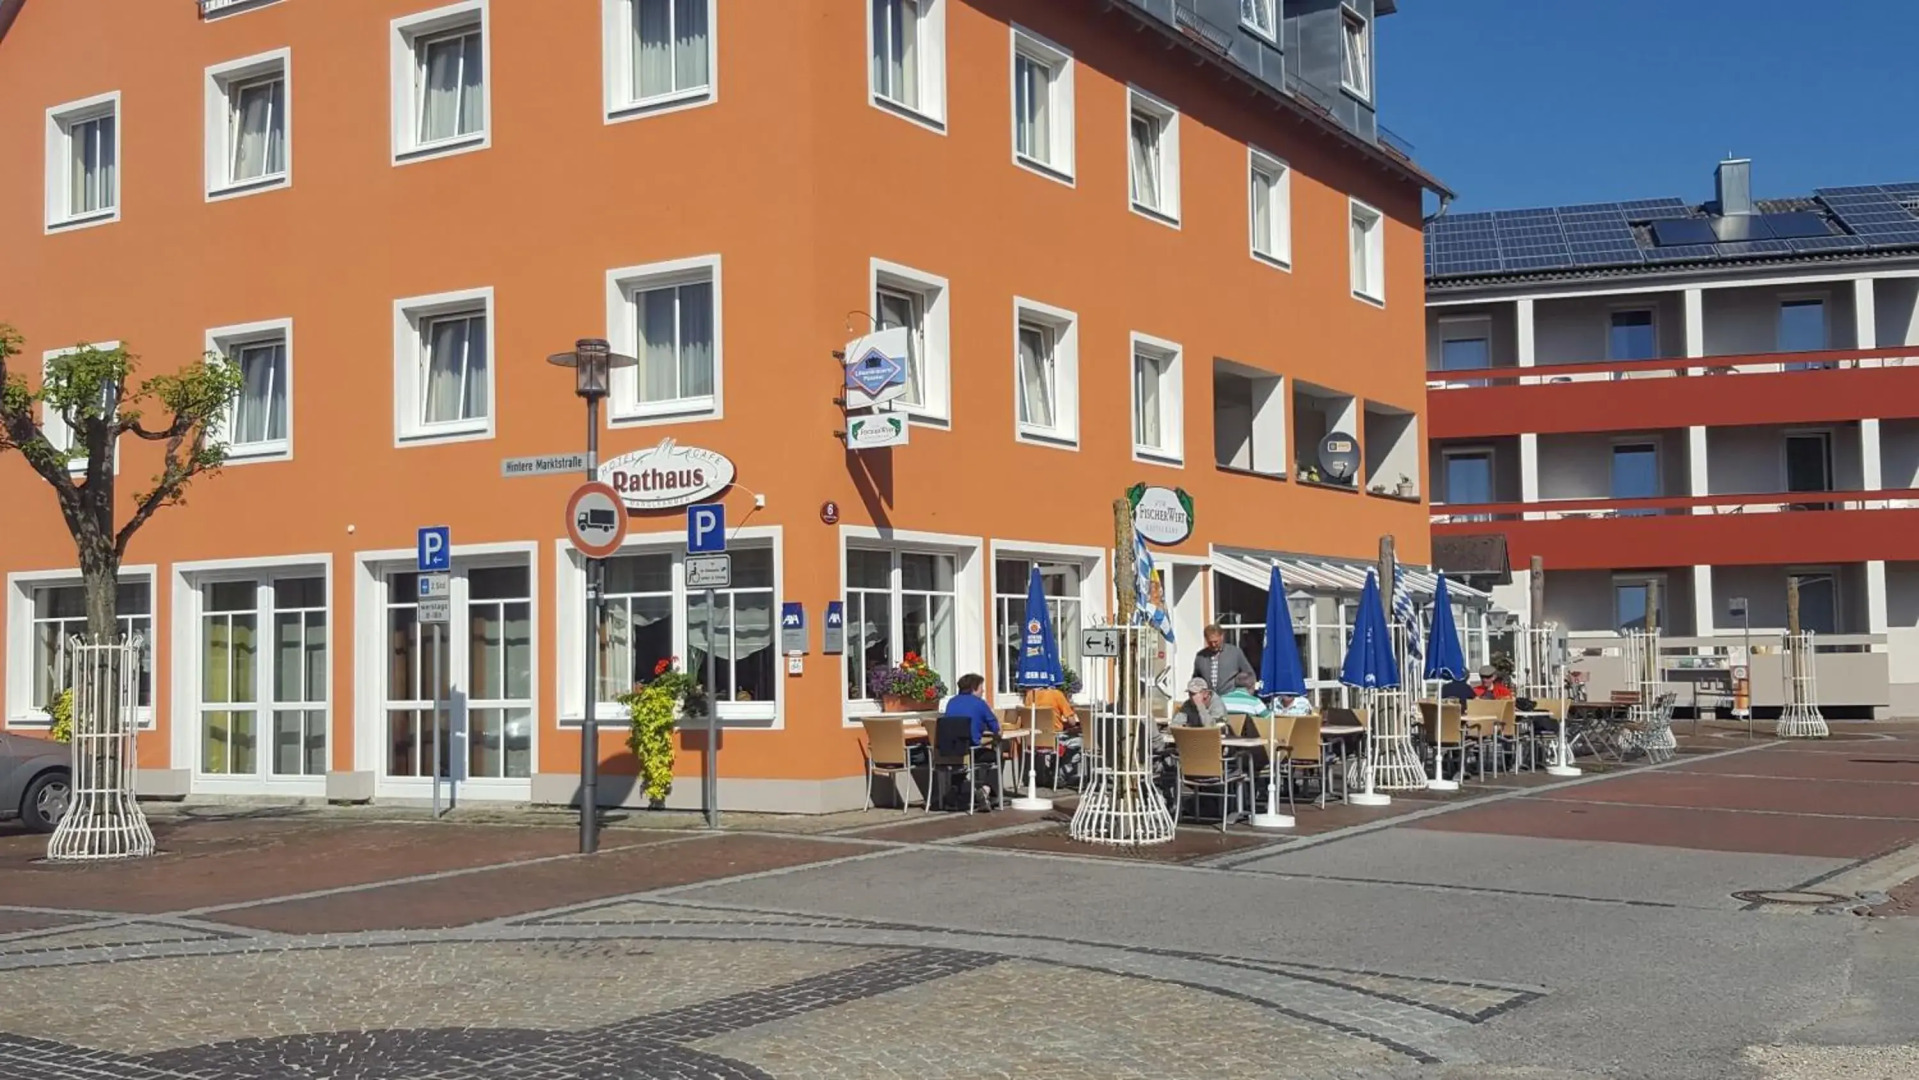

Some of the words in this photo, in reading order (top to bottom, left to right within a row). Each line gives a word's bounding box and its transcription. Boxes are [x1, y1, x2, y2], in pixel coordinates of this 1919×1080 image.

[505, 461, 533, 473] Hintere
[535, 455, 583, 471] Marktstraße
[601, 453, 636, 476] HOTEL
[612, 467, 705, 493] Rathaus
[826, 503, 834, 515] 6
[696, 510, 717, 547] P
[425, 532, 443, 566] P
[782, 614, 800, 626] AXA
[828, 612, 841, 624] AXA
